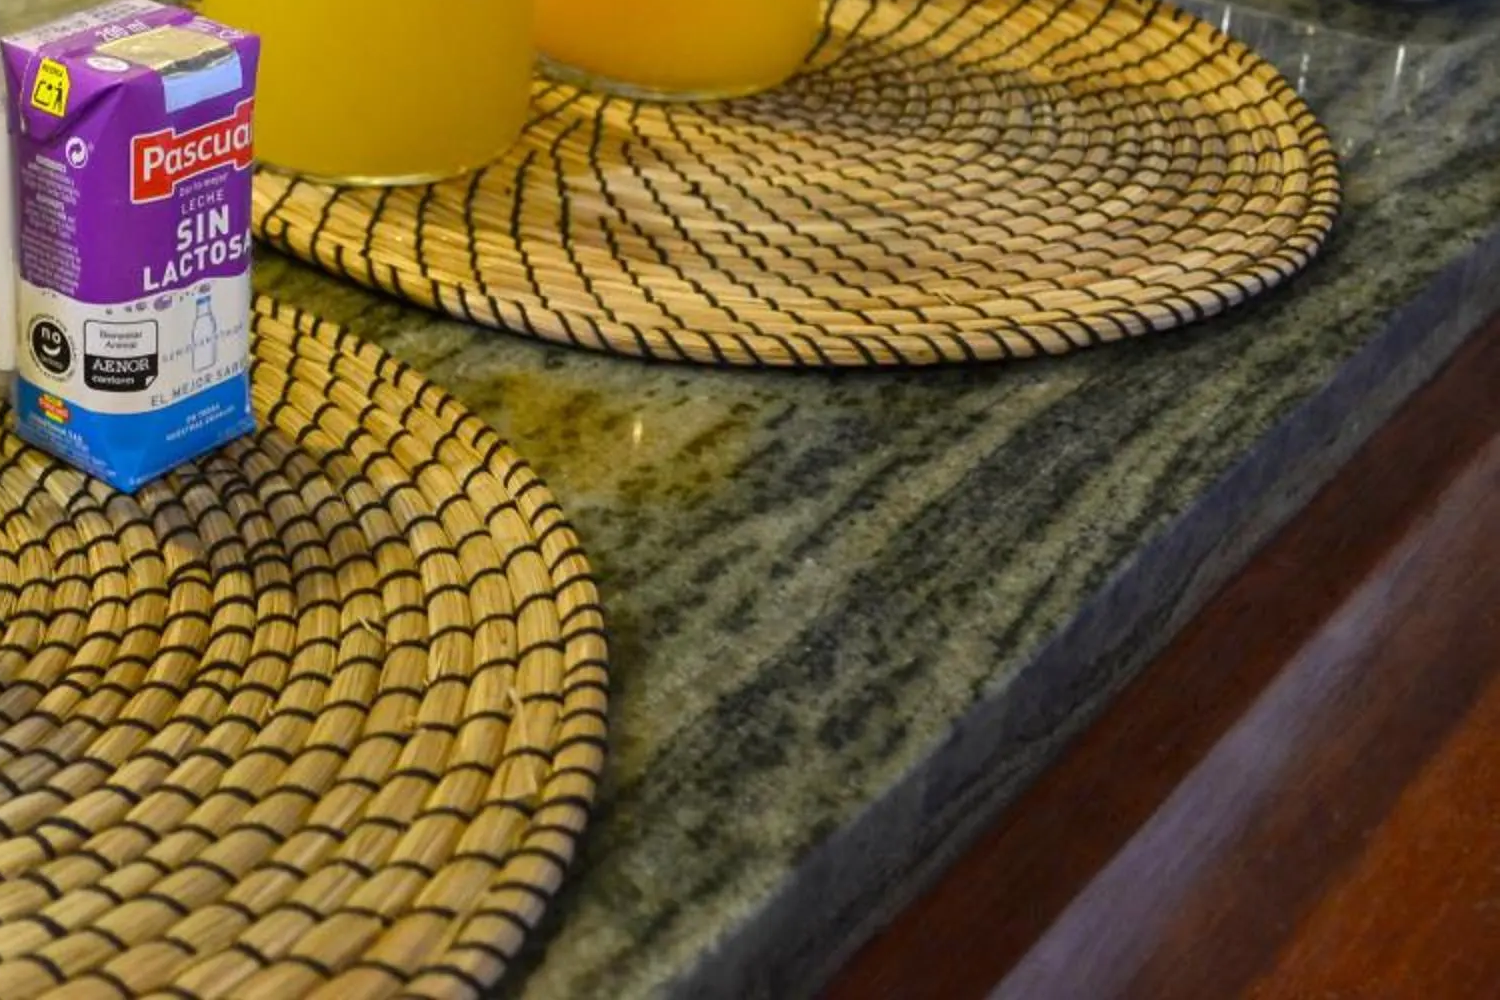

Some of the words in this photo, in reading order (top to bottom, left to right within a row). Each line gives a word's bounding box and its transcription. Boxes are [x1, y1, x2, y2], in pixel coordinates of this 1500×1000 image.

[142, 121, 252, 182] Pascua
[181, 188, 224, 215] LECHE
[176, 204, 229, 251] SIN
[143, 228, 252, 291] LACTOSA
[41, 326, 62, 344] no
[91, 358, 150, 374] AENOR
[151, 394, 169, 407] EL
